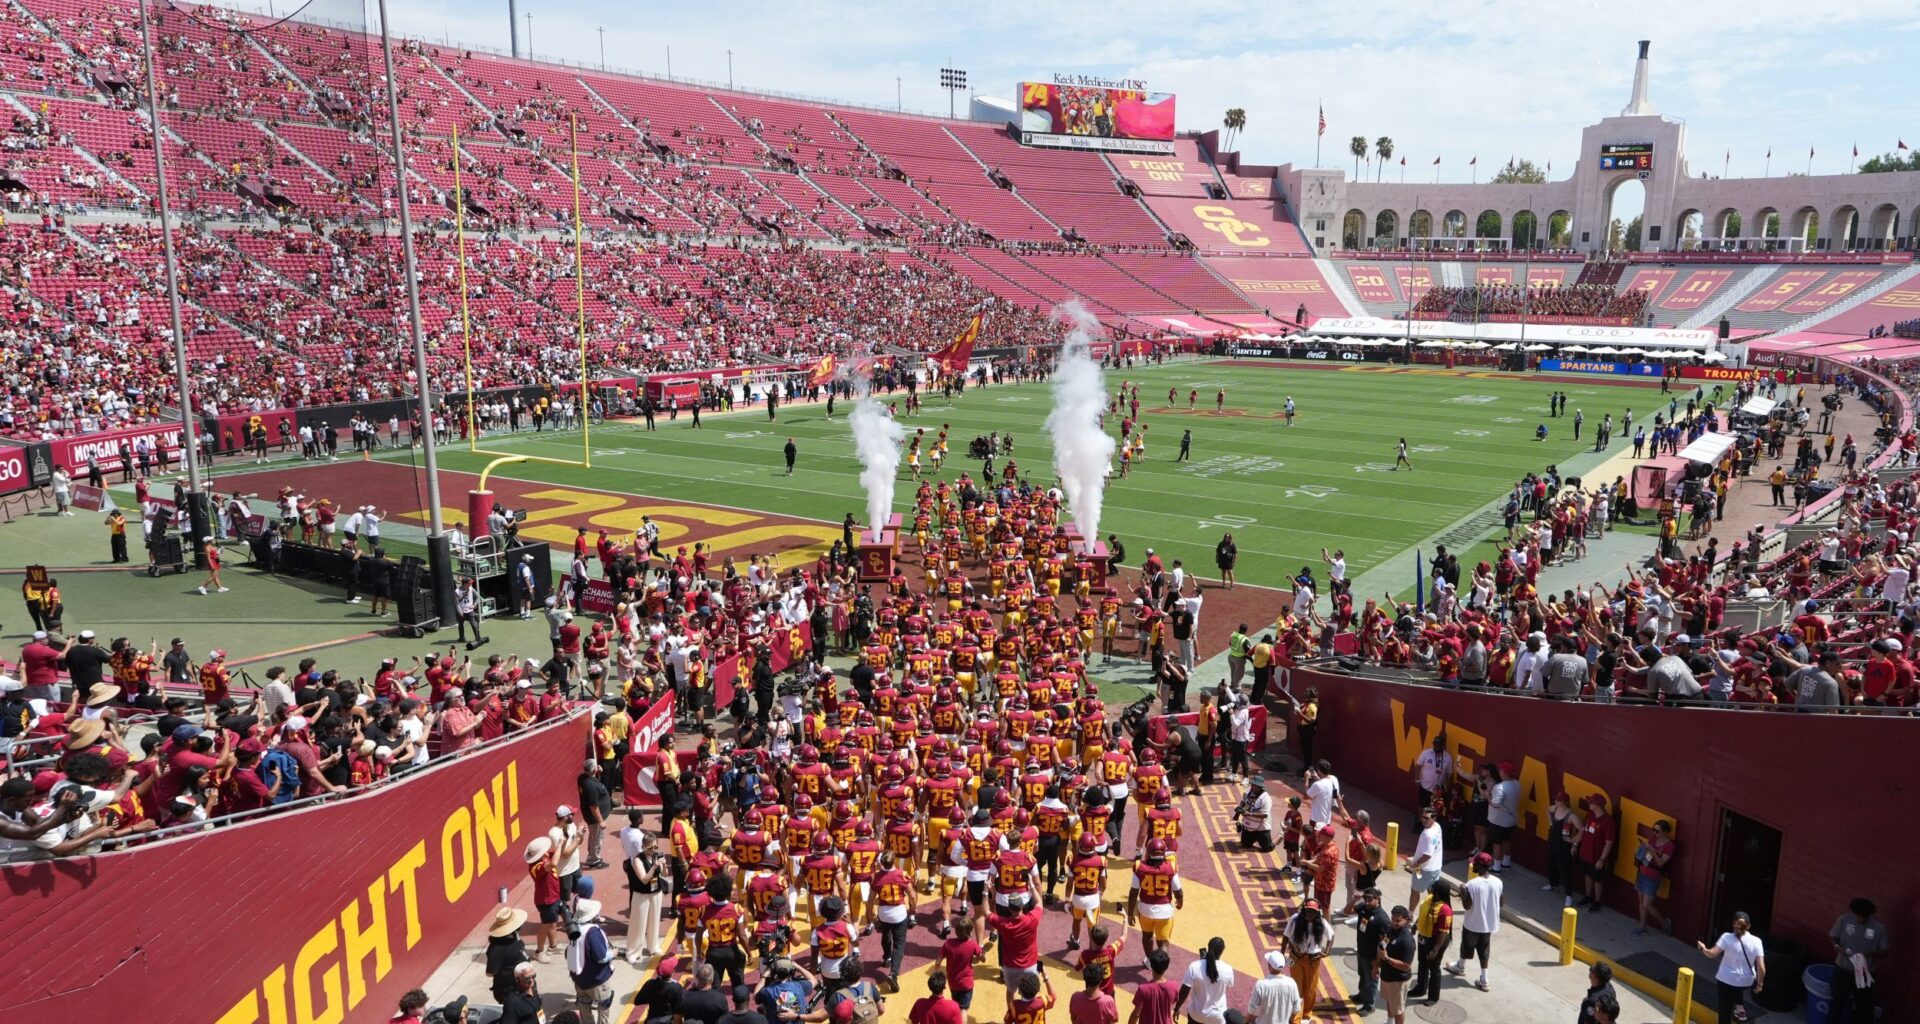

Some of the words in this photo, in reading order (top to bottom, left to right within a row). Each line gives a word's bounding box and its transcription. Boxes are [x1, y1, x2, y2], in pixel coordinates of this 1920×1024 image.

[1054, 73, 1075, 84] Keck
[1078, 75, 1116, 88] Medicine
[1116, 79, 1126, 88] of
[1128, 80, 1147, 90] USC
[1101, 139, 1118, 148] Keck
[1120, 140, 1147, 149] Medicine
[1158, 142, 1173, 151] USC
[1129, 160, 1185, 172] FIGHT
[1149, 171, 1182, 182] ON!
[1355, 275, 1385, 287] 20
[1638, 279, 1660, 291] 3
[1685, 281, 1712, 292] 11
[1773, 282, 1802, 294] 5
[1655, 331, 1705, 340] Audi
[1754, 353, 1775, 363] Audi
[1560, 361, 1615, 372] SPARTANS
[74, 440, 120, 462] MORGAN
[582, 587, 614, 599] ECHANG
[1055, 678, 1072, 694] 74
[880, 696, 890, 711] 9
[651, 702, 672, 732] United
[1105, 760, 1128, 780] 84
[795, 774, 819, 793] 78
[1025, 783, 1045, 803] 19
[441, 759, 521, 904] ON!
[735, 844, 762, 864] 36
[970, 840, 992, 861] 61
[850, 851, 877, 874] 47
[1073, 867, 1100, 889] 29
[1140, 875, 1170, 897] 45
[706, 917, 736, 942] 82
